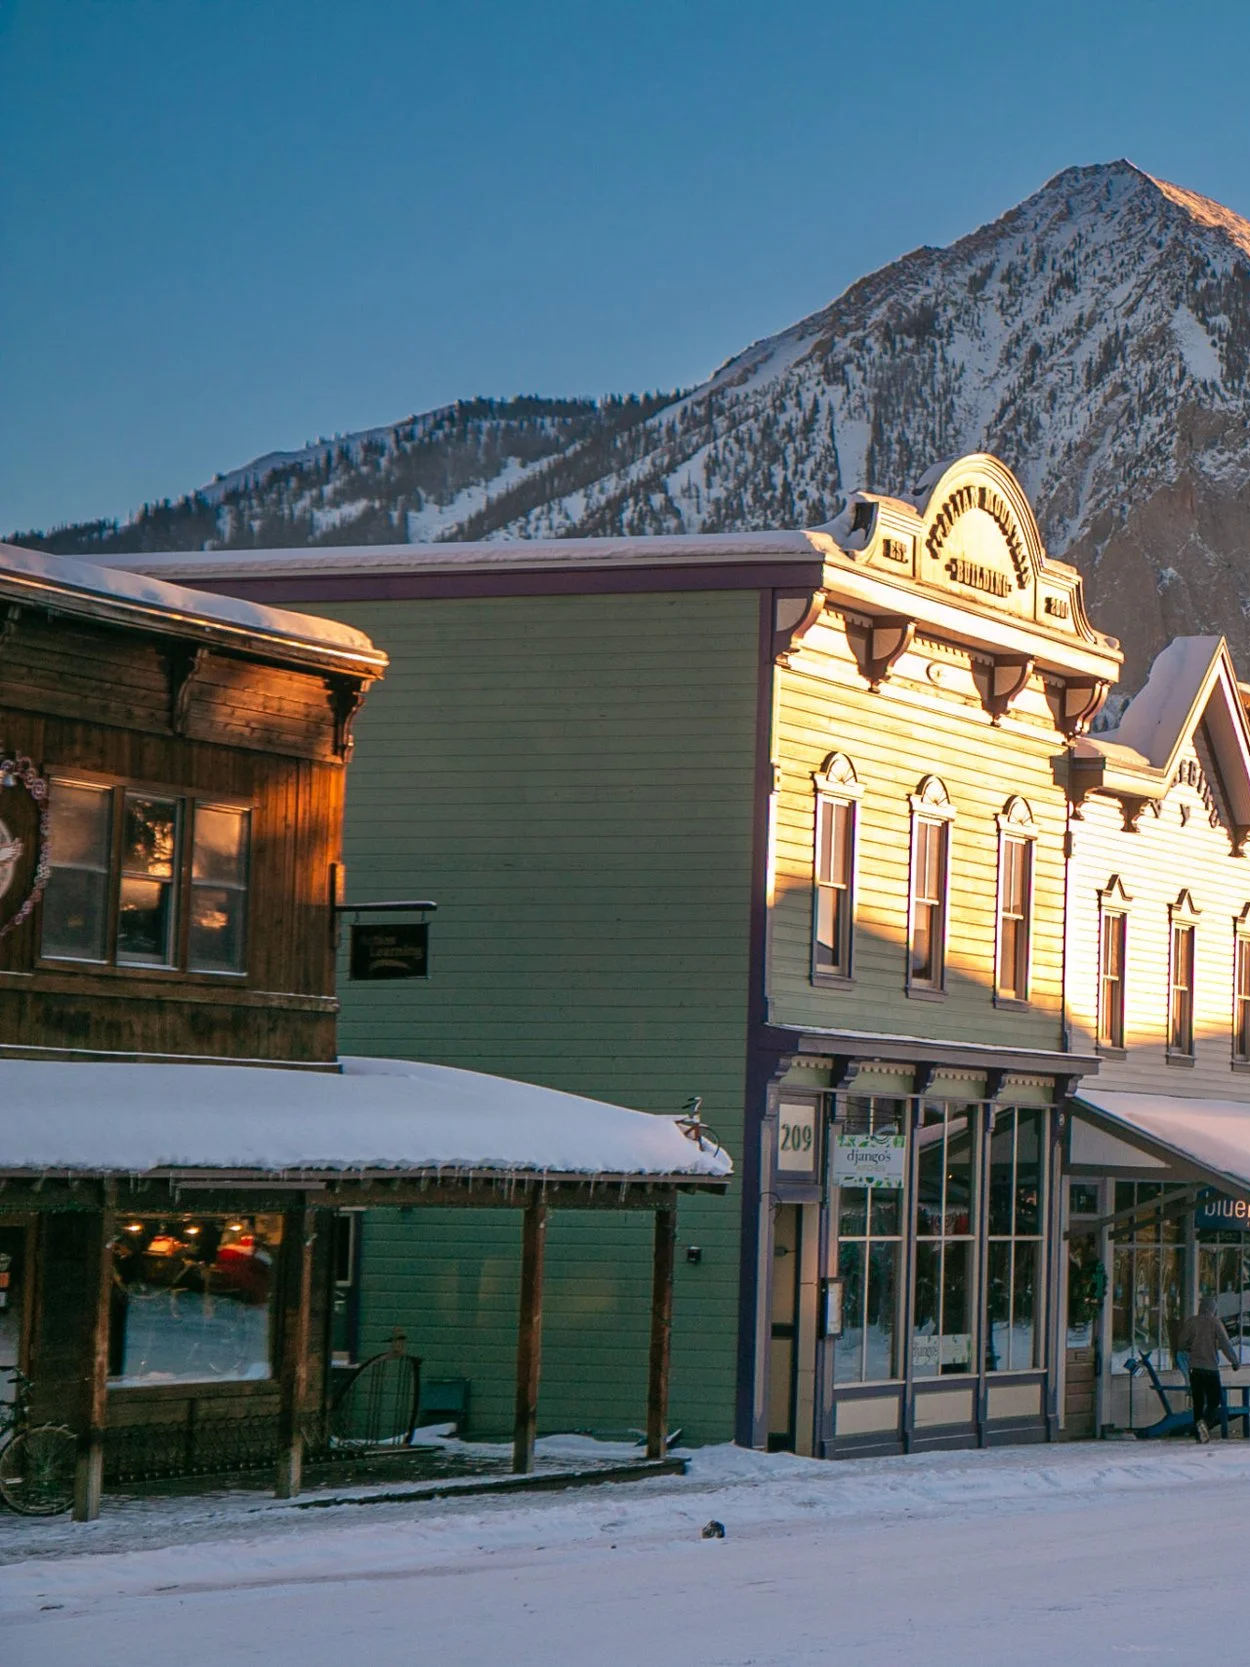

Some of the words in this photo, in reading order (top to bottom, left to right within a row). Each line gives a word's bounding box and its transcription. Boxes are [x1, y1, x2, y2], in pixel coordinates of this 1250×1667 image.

[926, 486, 979, 560] ITALIAN
[951, 558, 1008, 598] BUILDING
[781, 1123, 812, 1152] 209
[846, 1149, 892, 1166] django's
